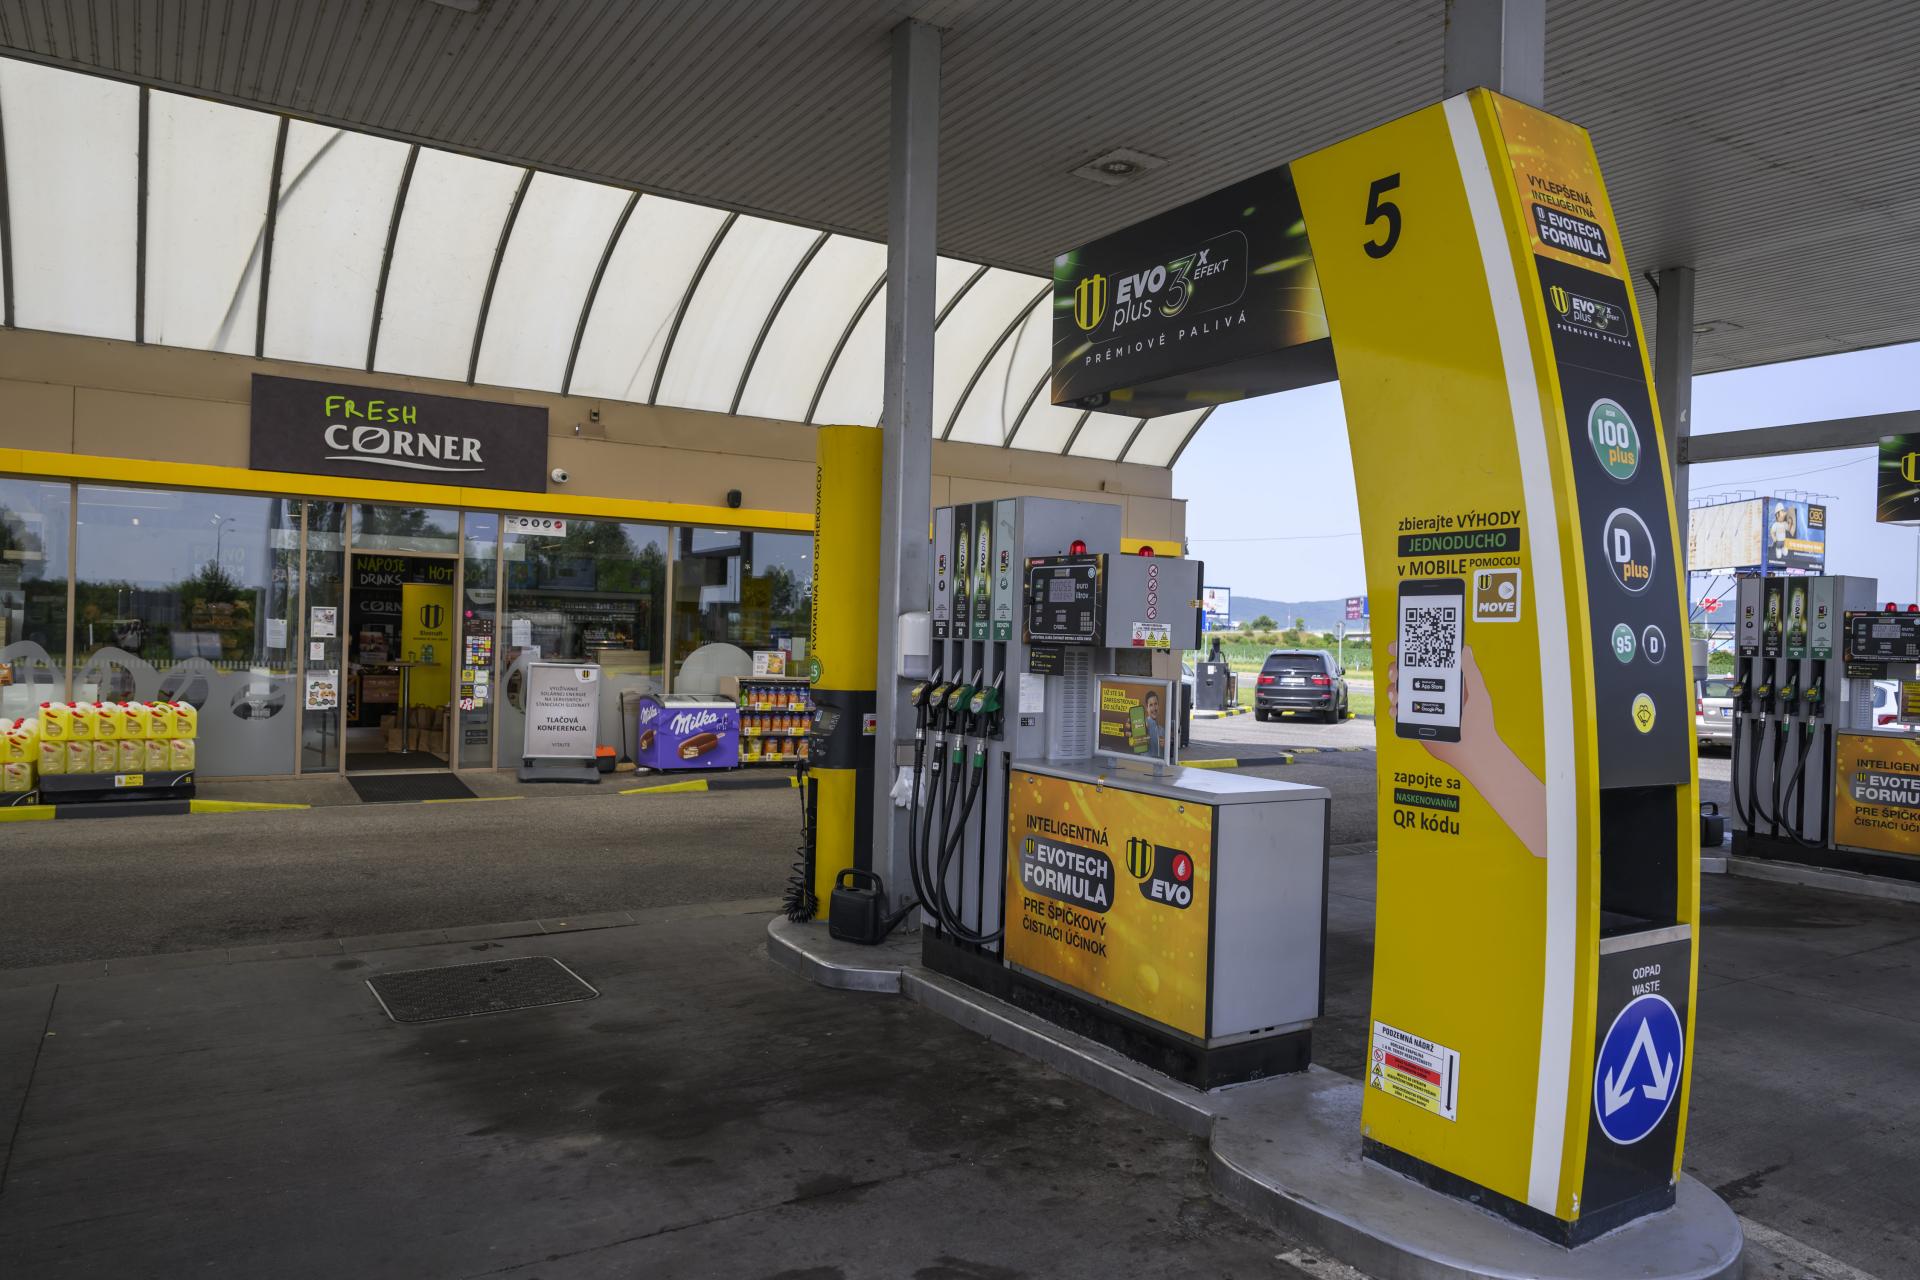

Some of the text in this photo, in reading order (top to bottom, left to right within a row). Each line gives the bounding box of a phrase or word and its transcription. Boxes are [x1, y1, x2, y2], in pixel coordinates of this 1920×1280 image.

[1527, 173, 1592, 206] VYLEPŠENÁ
[1531, 188, 1596, 219] INTELIGENTNÁ
[1363, 172, 1401, 259] 5
[1549, 212, 1601, 241] EVOTECH
[1540, 224, 1606, 259] FORMULA
[1193, 258, 1229, 280] EFEKT
[1116, 265, 1166, 304] EVO
[1159, 253, 1197, 317] 3
[1112, 299, 1153, 332] plus
[1572, 297, 1595, 314] EVO
[1573, 309, 1593, 324] plus
[1085, 309, 1246, 367] PRÉMIOVÉ PALIVÁ
[325, 395, 417, 425] FRESH
[324, 424, 483, 463] CORNER
[1597, 418, 1629, 448] 100
[1608, 445, 1635, 467] plus
[1398, 510, 1521, 532] zbierajte VÝHODY
[1408, 532, 1507, 552] JEDNODUCHO
[1614, 527, 1631, 563] D
[429, 564, 454, 580] HOT
[813, 563, 820, 582] DO
[1397, 557, 1520, 576] v MOBILE POMOCOU
[1623, 559, 1649, 581] plus
[360, 573, 402, 586] DRINKS
[360, 600, 402, 612] CORN
[1478, 602, 1515, 612] MOVE
[811, 584, 820, 651] KVAPALINA
[1616, 635, 1632, 653] 95
[1649, 636, 1658, 653] D
[546, 716, 579, 724] TLAČOVÁ
[640, 704, 658, 725] Milka
[670, 709, 718, 735] Milka
[537, 724, 587, 732] KONFERENCIA
[1856, 759, 1920, 772] INTELIGEN
[1394, 771, 1461, 790] zapojte sa
[1869, 775, 1920, 790] EVOTE
[1396, 792, 1457, 809] NASKENOVANÍM
[1855, 786, 1920, 805] FORMU
[1393, 809, 1460, 835] QR kódu
[1855, 806, 1878, 817] PRE
[1026, 814, 1109, 847] INTELIGENTNÁ
[1854, 817, 1898, 830] ČISTIACI
[1037, 844, 1108, 880] EVOTECH
[1024, 862, 1108, 907] FORMULA
[1151, 878, 1191, 906] EVO
[1023, 896, 1107, 936] PRE ŠPIČKOVÝ
[1022, 916, 1108, 959] ČISTIACI ÚČINOK
[1632, 964, 1661, 980] ODPAD
[1631, 979, 1661, 996] WASTE
[1382, 1026, 1435, 1053] PODZEMNÁ NÁDRŽ
